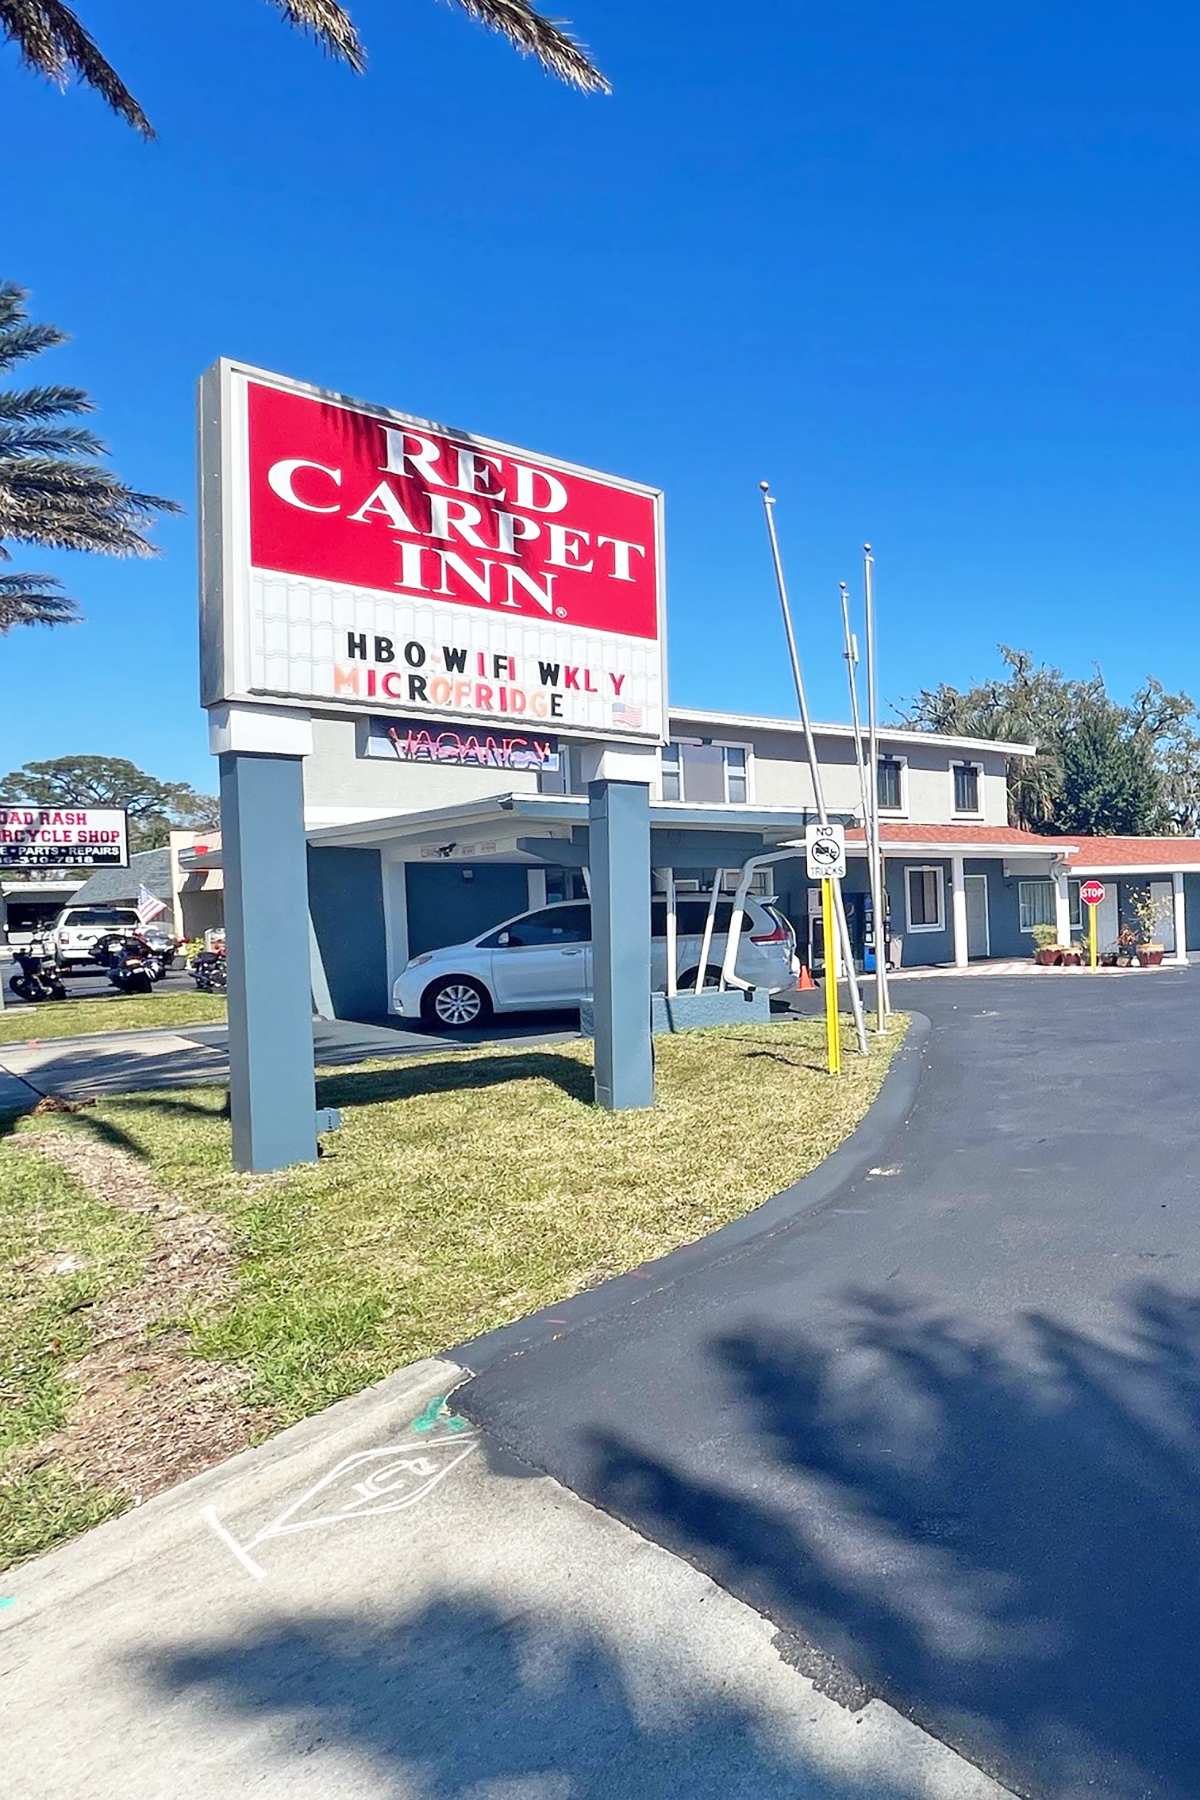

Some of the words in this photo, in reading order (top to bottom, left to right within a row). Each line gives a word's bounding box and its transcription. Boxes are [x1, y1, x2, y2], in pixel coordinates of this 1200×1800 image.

[378, 424, 568, 513] RED
[268, 458, 646, 582] CARPET
[347, 631, 426, 668] HBO
[538, 660, 626, 696] WKLY
[333, 666, 563, 718] MICROFRIDGE
[389, 727, 550, 765] VACANCY
[38, 811, 87, 825] RASH
[1, 830, 72, 842] RCYCLE
[77, 830, 120, 843] SHOP
[816, 826, 834, 836] NO
[18, 846, 59, 855] PARTS
[68, 847, 120, 855] REPAIRS
[810, 866, 844, 876] TRUCKS
[1082, 888, 1105, 898] STOP
